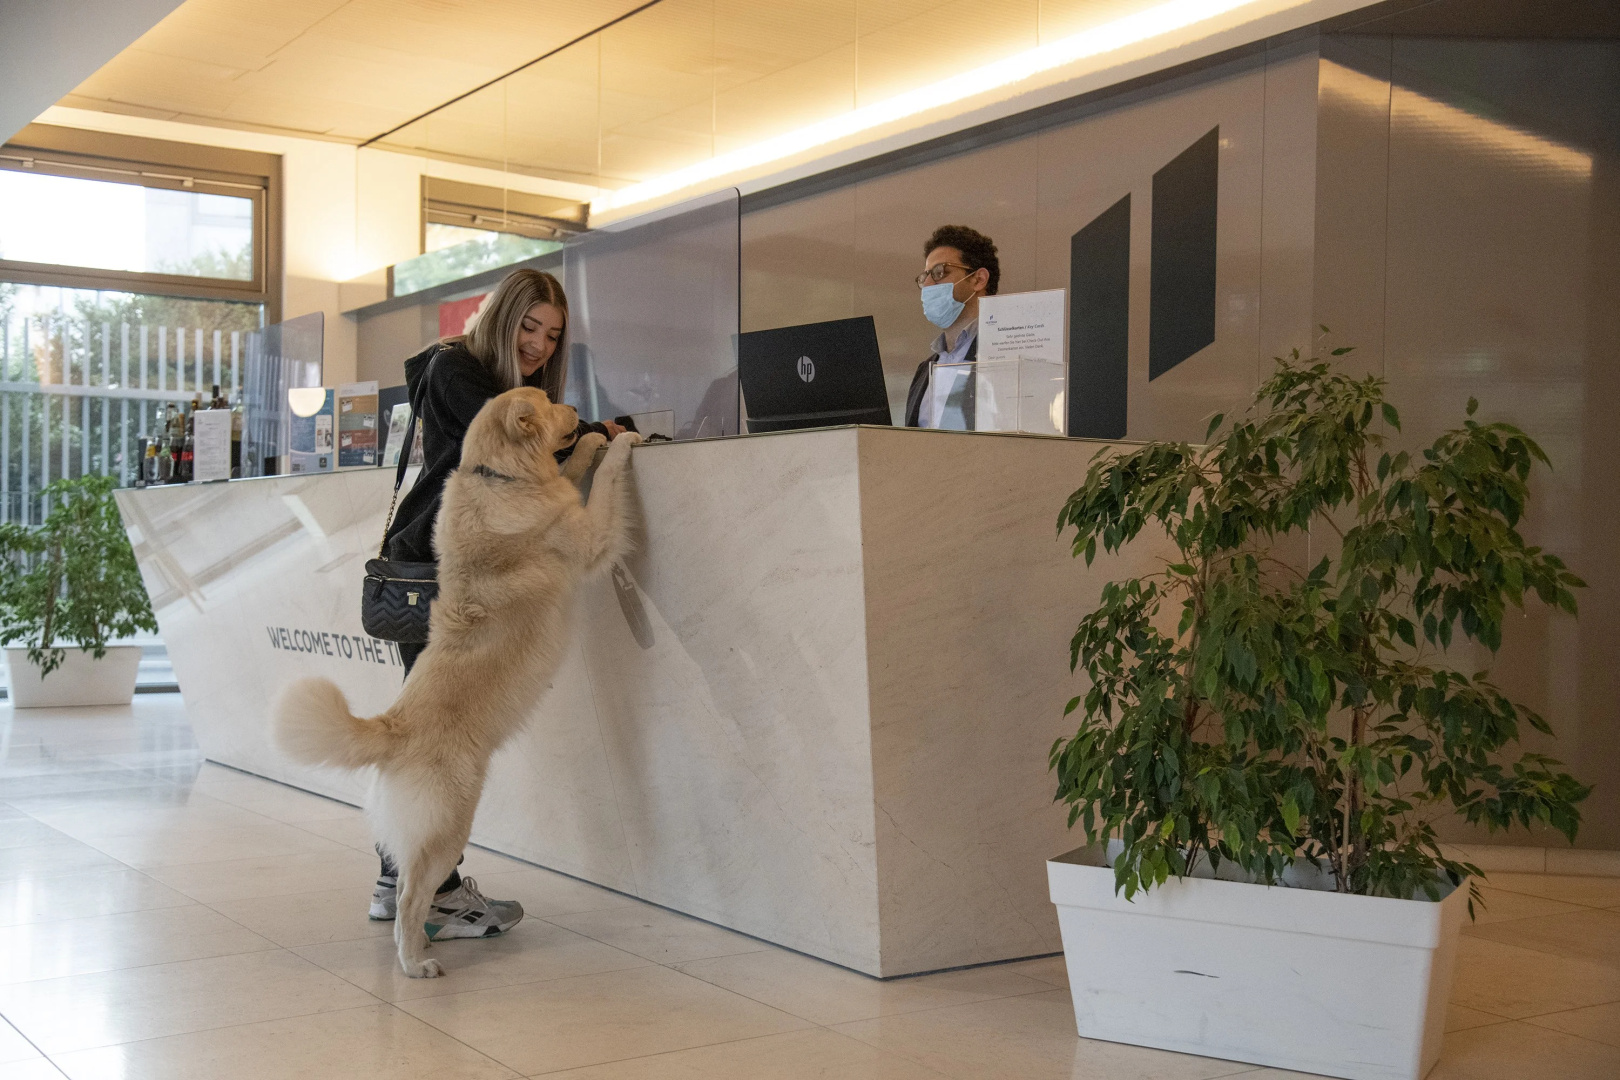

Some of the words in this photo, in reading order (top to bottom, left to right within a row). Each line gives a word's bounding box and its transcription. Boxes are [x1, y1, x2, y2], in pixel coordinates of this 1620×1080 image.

[800, 355, 812, 382] hp
[266, 626, 334, 656] WELCOME
[331, 633, 353, 659] TO
[352, 636, 386, 664] THE
